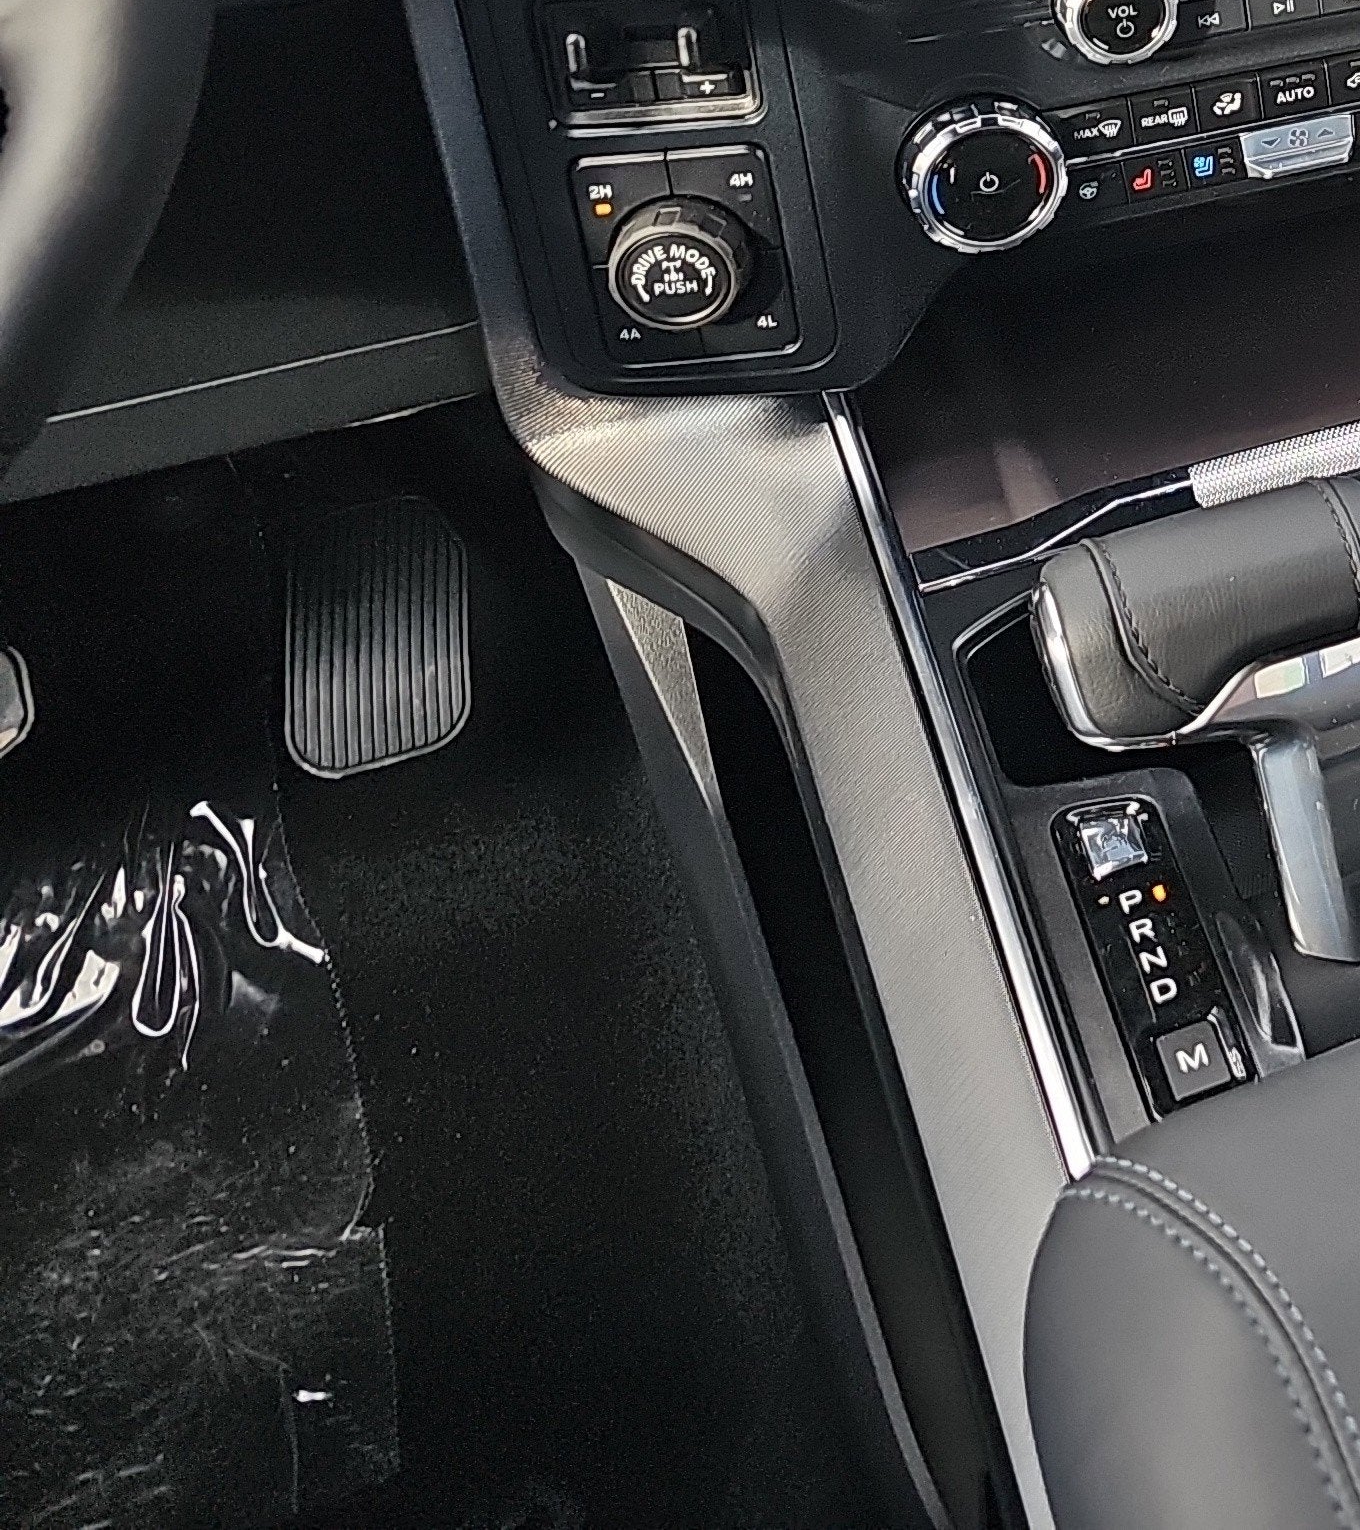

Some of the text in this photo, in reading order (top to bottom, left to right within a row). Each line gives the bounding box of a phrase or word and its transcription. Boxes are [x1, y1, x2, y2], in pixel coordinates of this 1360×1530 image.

[1107, 3, 1138, 19] VOL
[1276, 85, 1315, 104] AUTO
[1141, 115, 1168, 128] REAR
[1073, 126, 1100, 140] MAX
[729, 171, 754, 188] 4H
[588, 183, 613, 200] 2H
[630, 243, 717, 286] DRIVE MODE
[653, 279, 698, 296] PUSH
[756, 314, 778, 330] 4L
[619, 327, 641, 341] 4A
[1118, 888, 1143, 915] P
[1129, 918, 1156, 944] R
[1138, 946, 1168, 974] N
[1150, 977, 1178, 1005] D
[1175, 1042, 1210, 1075] M
